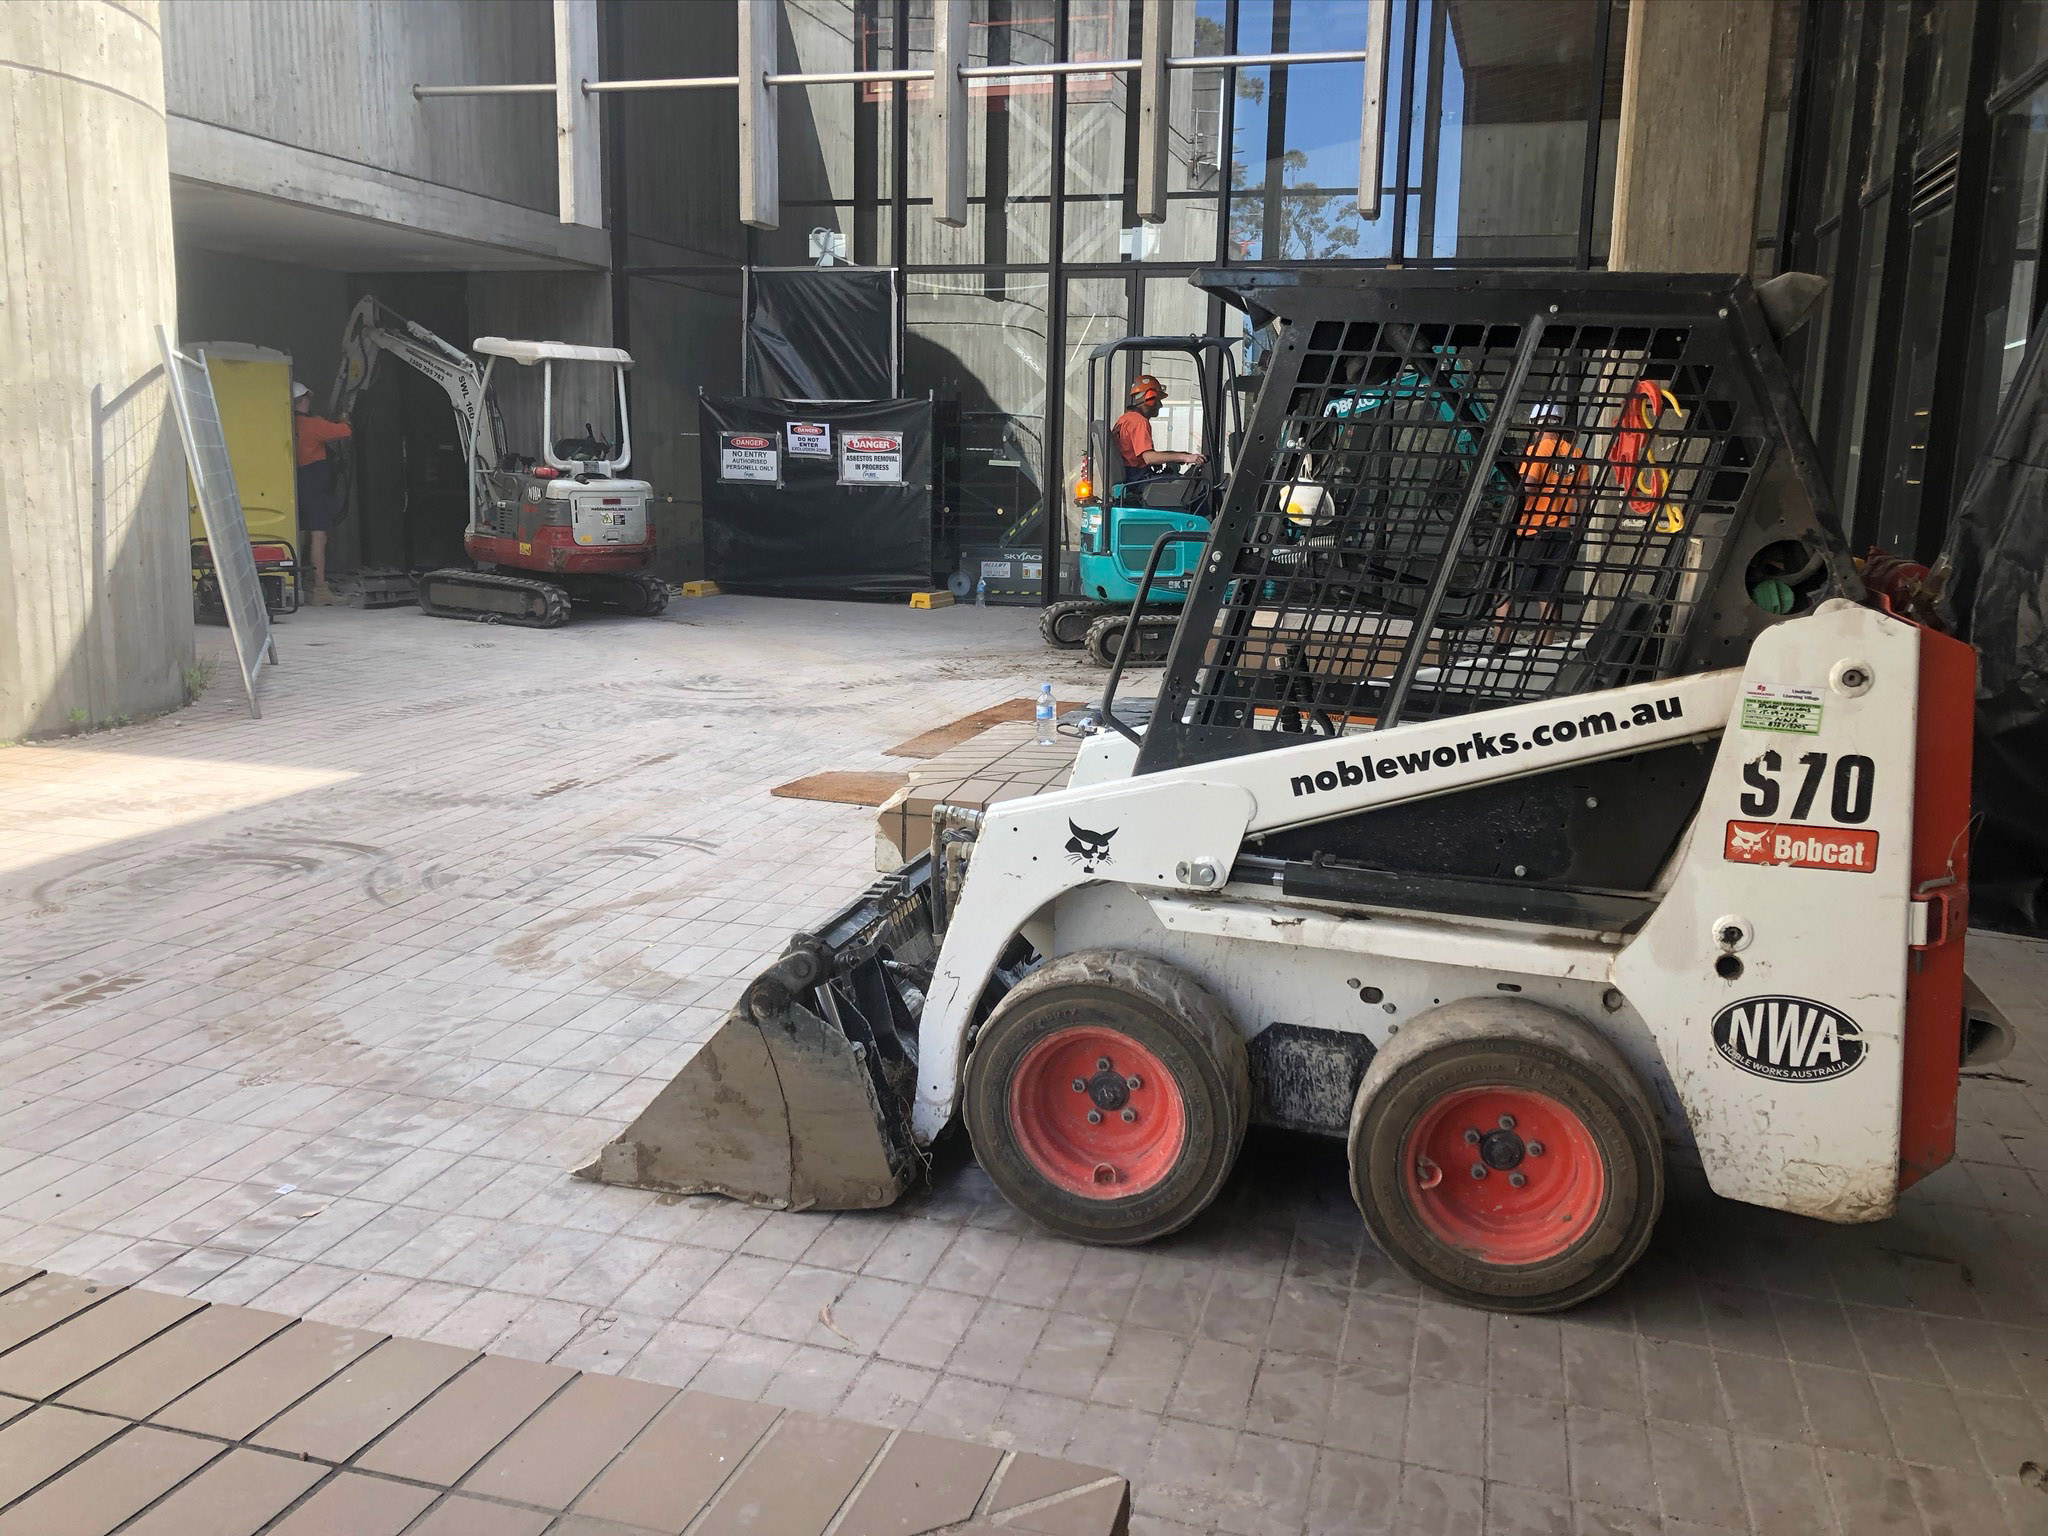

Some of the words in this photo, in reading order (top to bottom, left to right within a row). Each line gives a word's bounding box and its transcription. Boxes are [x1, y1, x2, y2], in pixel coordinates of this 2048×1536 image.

[459, 375, 470, 400] SWL
[736, 439, 764, 447] DANGER
[853, 440, 891, 449] DANGER
[854, 463, 861, 471] IN
[861, 463, 890, 471] PROGRESS
[873, 455, 899, 463] REMOVAL
[1290, 695, 1684, 798] nobleworks.com.au
[1740, 749, 1876, 825] S70
[1773, 834, 1866, 866] Bobcat
[1728, 1002, 1842, 1068] NWA
[1721, 1043, 1751, 1067] NOBLE
[1752, 1062, 1790, 1078] WORKS
[1790, 1061, 1850, 1079] AUSTRALIA
